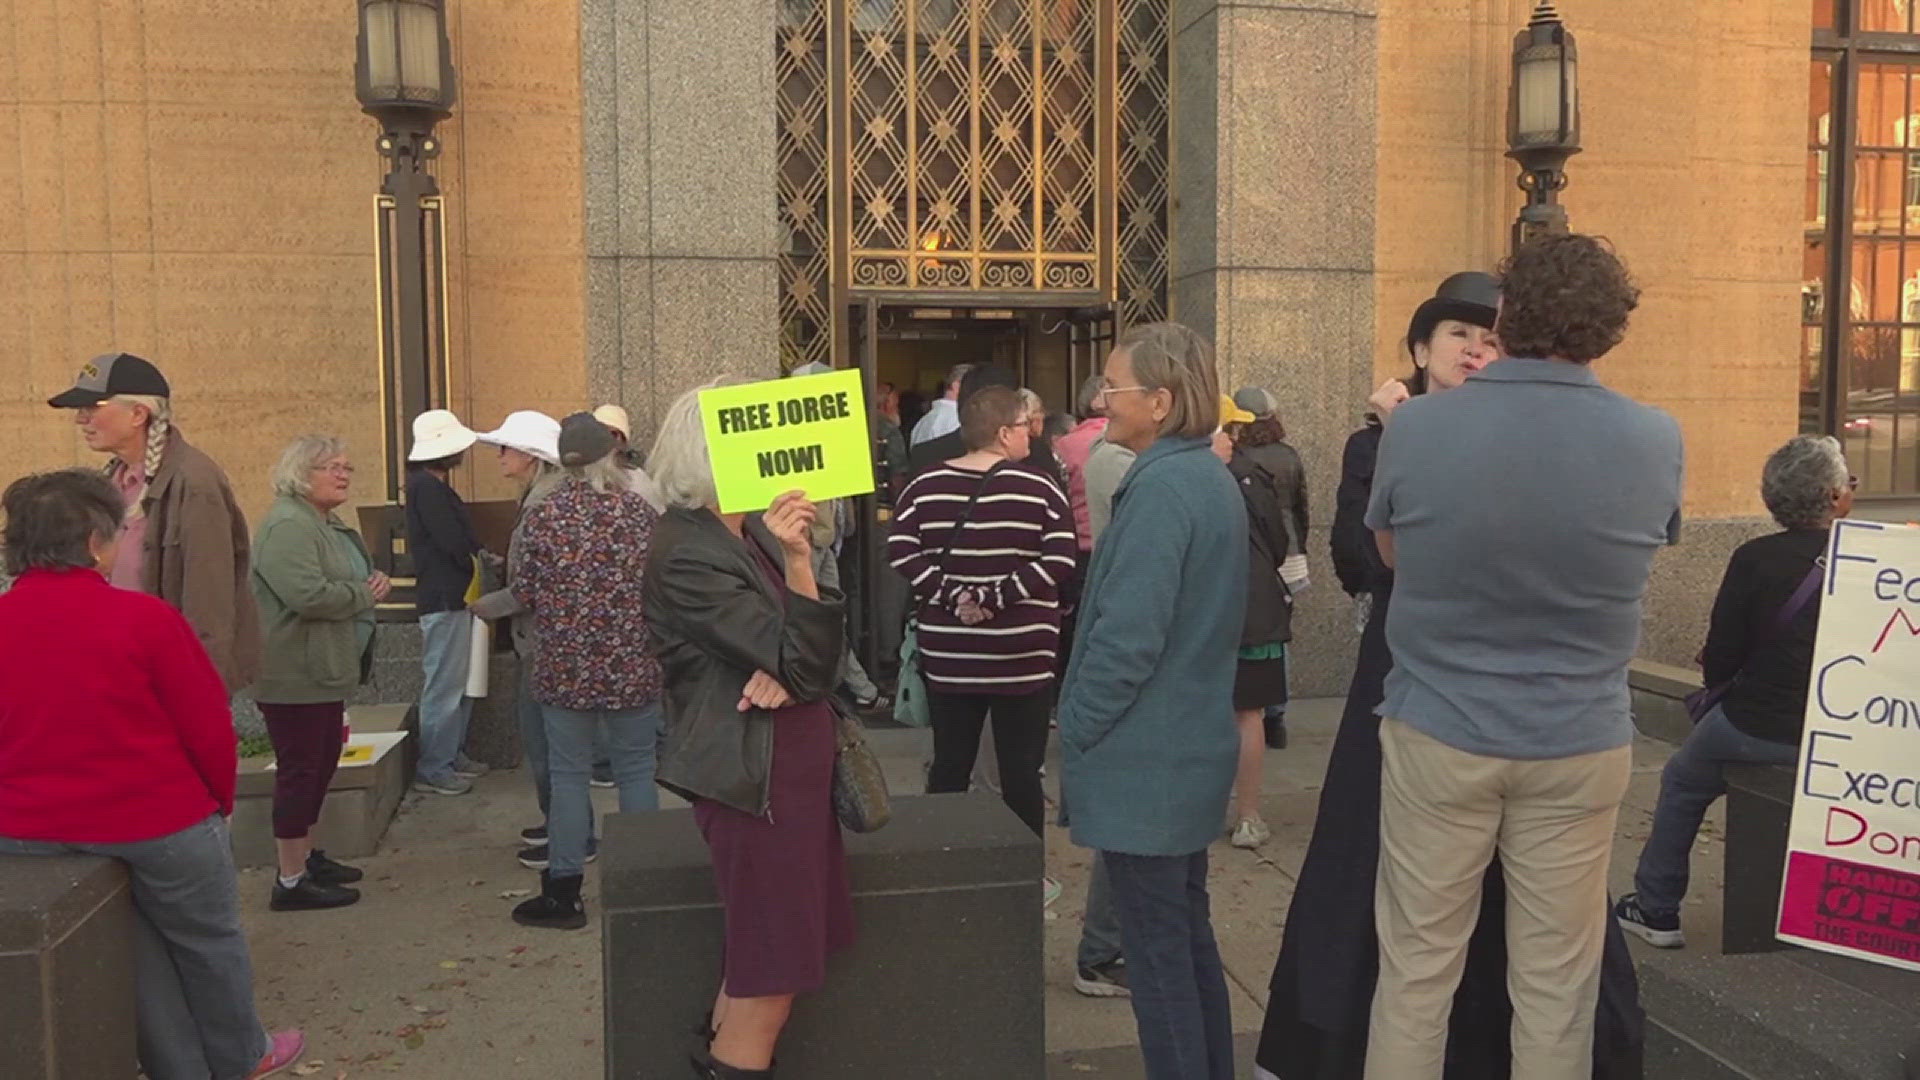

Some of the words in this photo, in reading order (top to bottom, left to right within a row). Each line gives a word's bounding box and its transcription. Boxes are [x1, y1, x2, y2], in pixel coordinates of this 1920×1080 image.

[717, 403, 773, 434] FREE
[777, 391, 850, 427] JORGE
[757, 444, 824, 478] NOW!
[1814, 919, 1850, 943] THE
